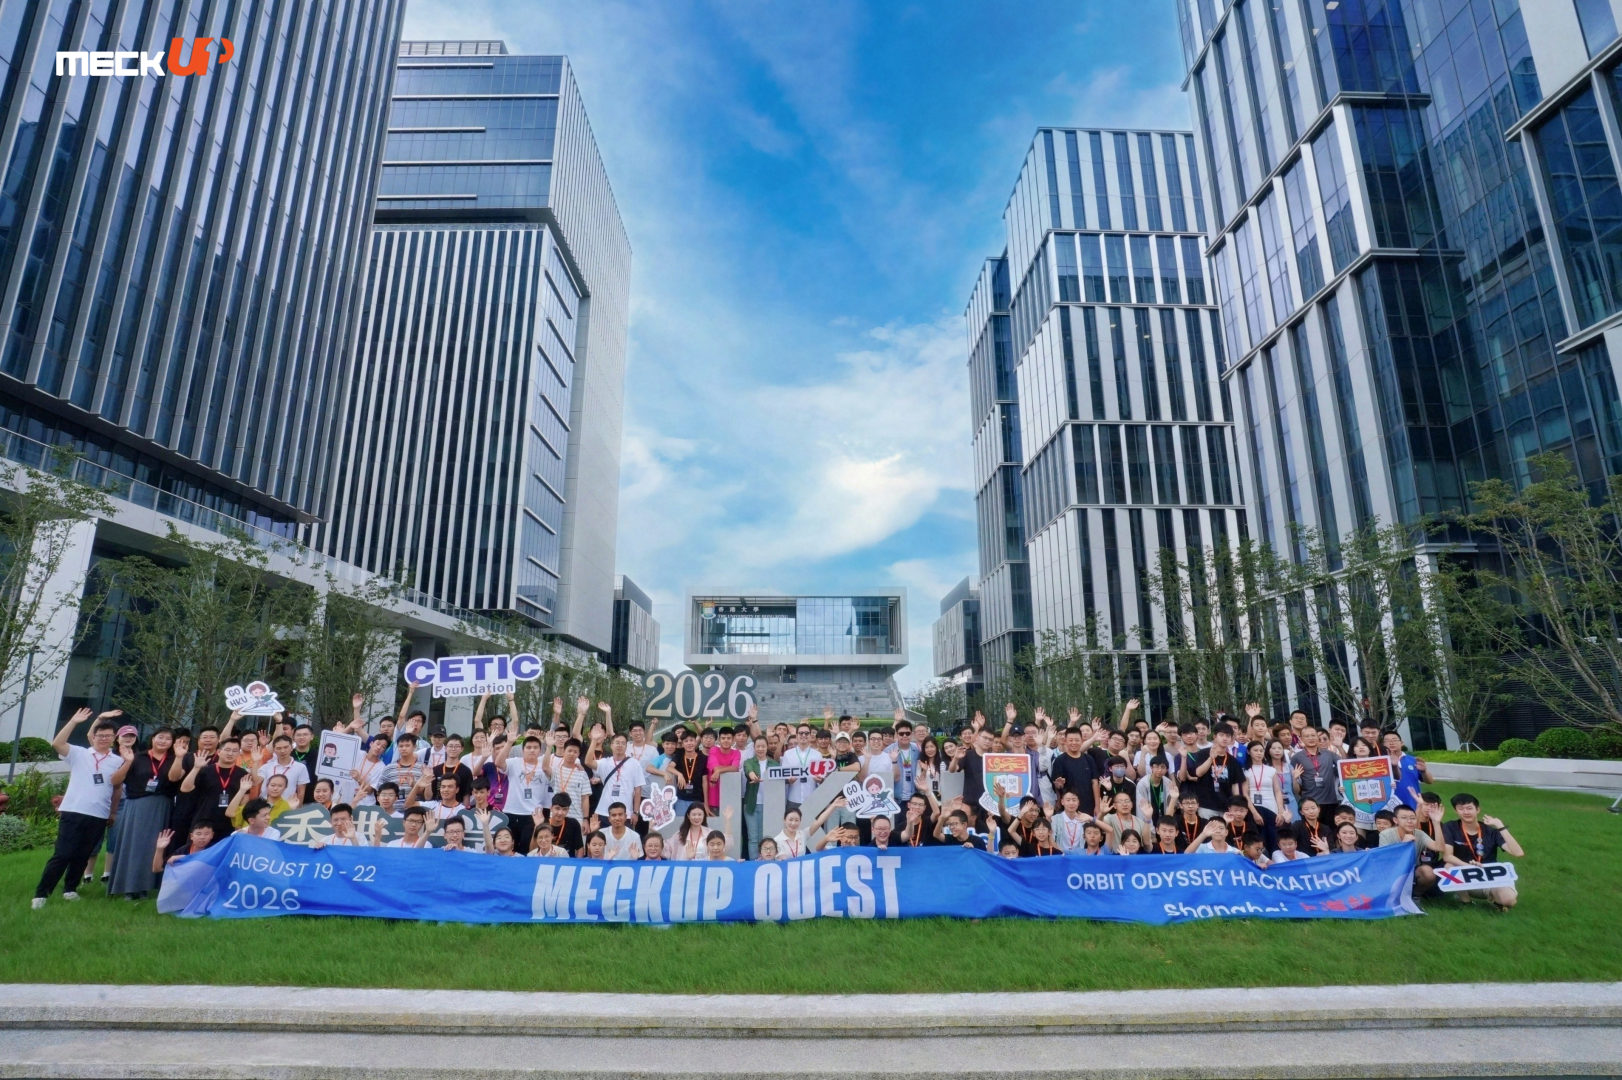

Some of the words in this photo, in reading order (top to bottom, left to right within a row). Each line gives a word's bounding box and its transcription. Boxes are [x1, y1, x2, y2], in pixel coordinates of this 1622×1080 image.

[406, 655, 540, 685] CETIC
[228, 688, 241, 697] GO
[229, 695, 248, 707] HKU
[434, 683, 514, 697] Foundation
[646, 674, 754, 719] 2026
[846, 785, 858, 796] GO
[848, 795, 866, 810] HKU
[229, 852, 308, 877] AUGUST
[313, 863, 334, 879] 19
[352, 865, 377, 882] 22
[1438, 865, 1507, 885] XRP
[1066, 873, 1125, 890] ORBIT
[1131, 869, 1225, 889] ODYSSEY
[1230, 867, 1362, 891] HACKATHON
[222, 880, 300, 911] 2026
[531, 864, 734, 923] MECKUP
